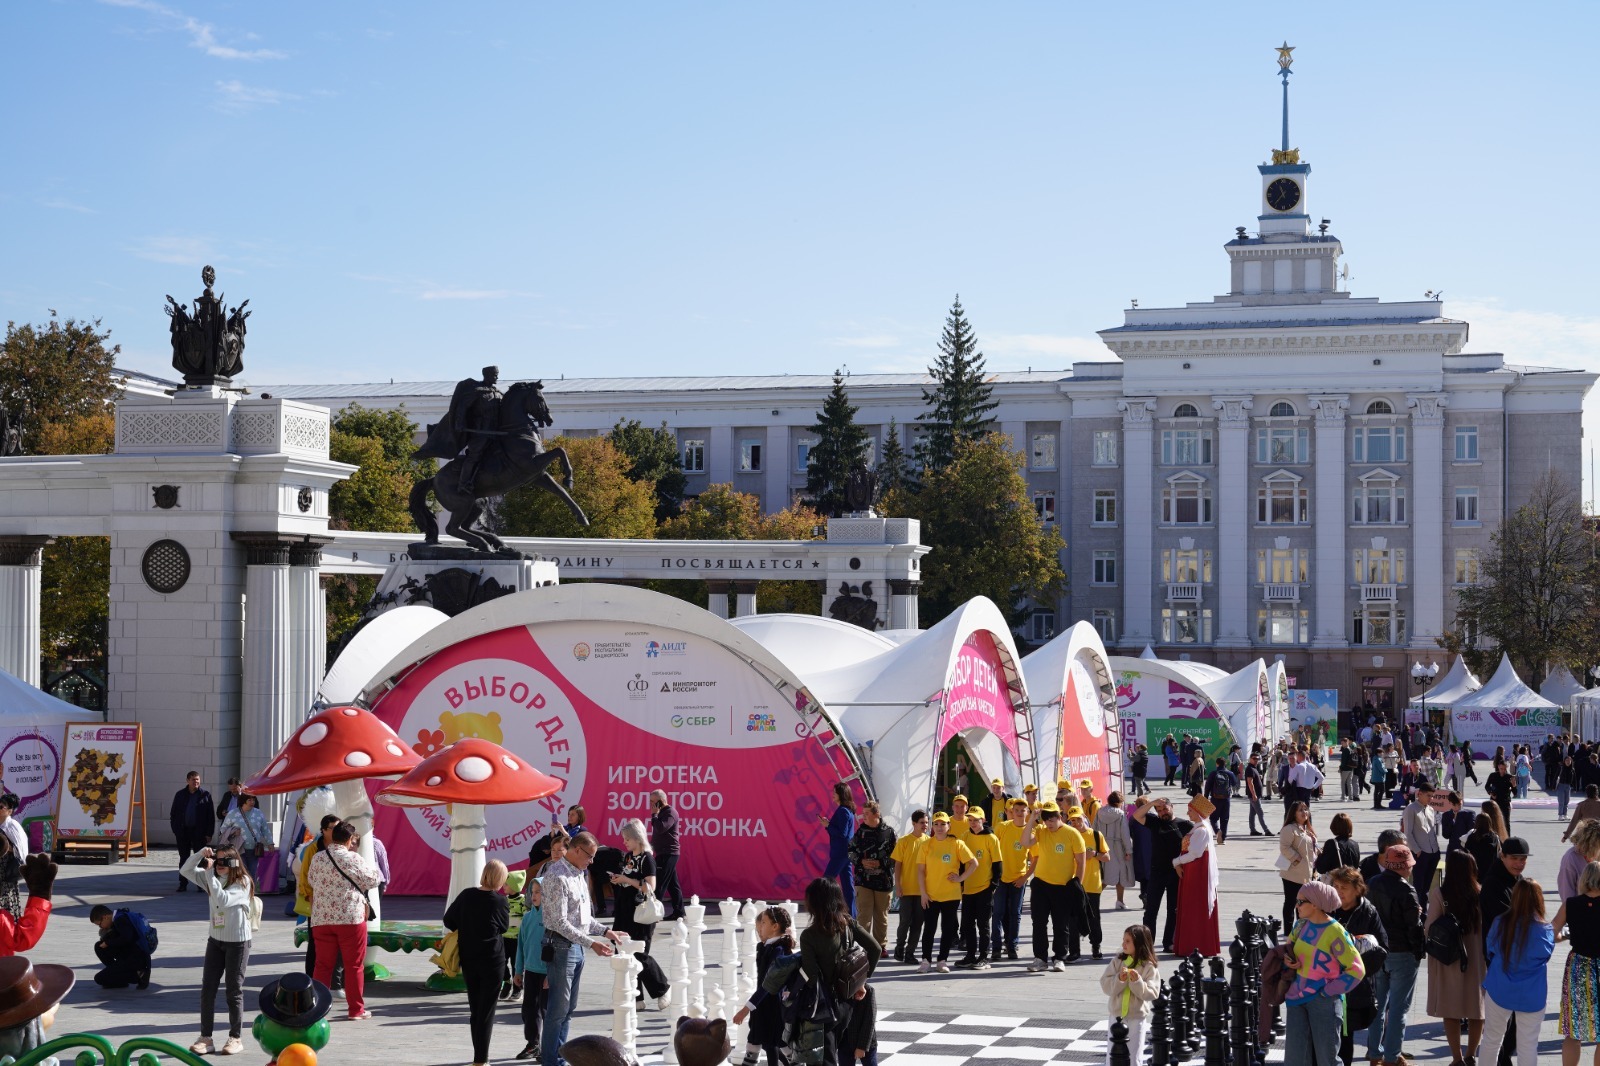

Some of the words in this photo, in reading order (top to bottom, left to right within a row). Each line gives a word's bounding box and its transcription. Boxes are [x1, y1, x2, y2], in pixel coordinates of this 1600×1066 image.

[352, 552, 358, 562] В
[661, 558, 804, 569] ПОСВЯЩАЕТСЯ
[661, 642, 687, 651] АИДТ
[973, 657, 998, 697] ДЕТЕЙ
[444, 676, 547, 709] ВЫБОР
[686, 716, 716, 726] СБЕР
[1178, 727, 1212, 735] сентября
[16, 753, 24, 761] Как
[608, 765, 719, 784] ИГРОТЕКА
[607, 791, 723, 811] ЗОЛТОГО
